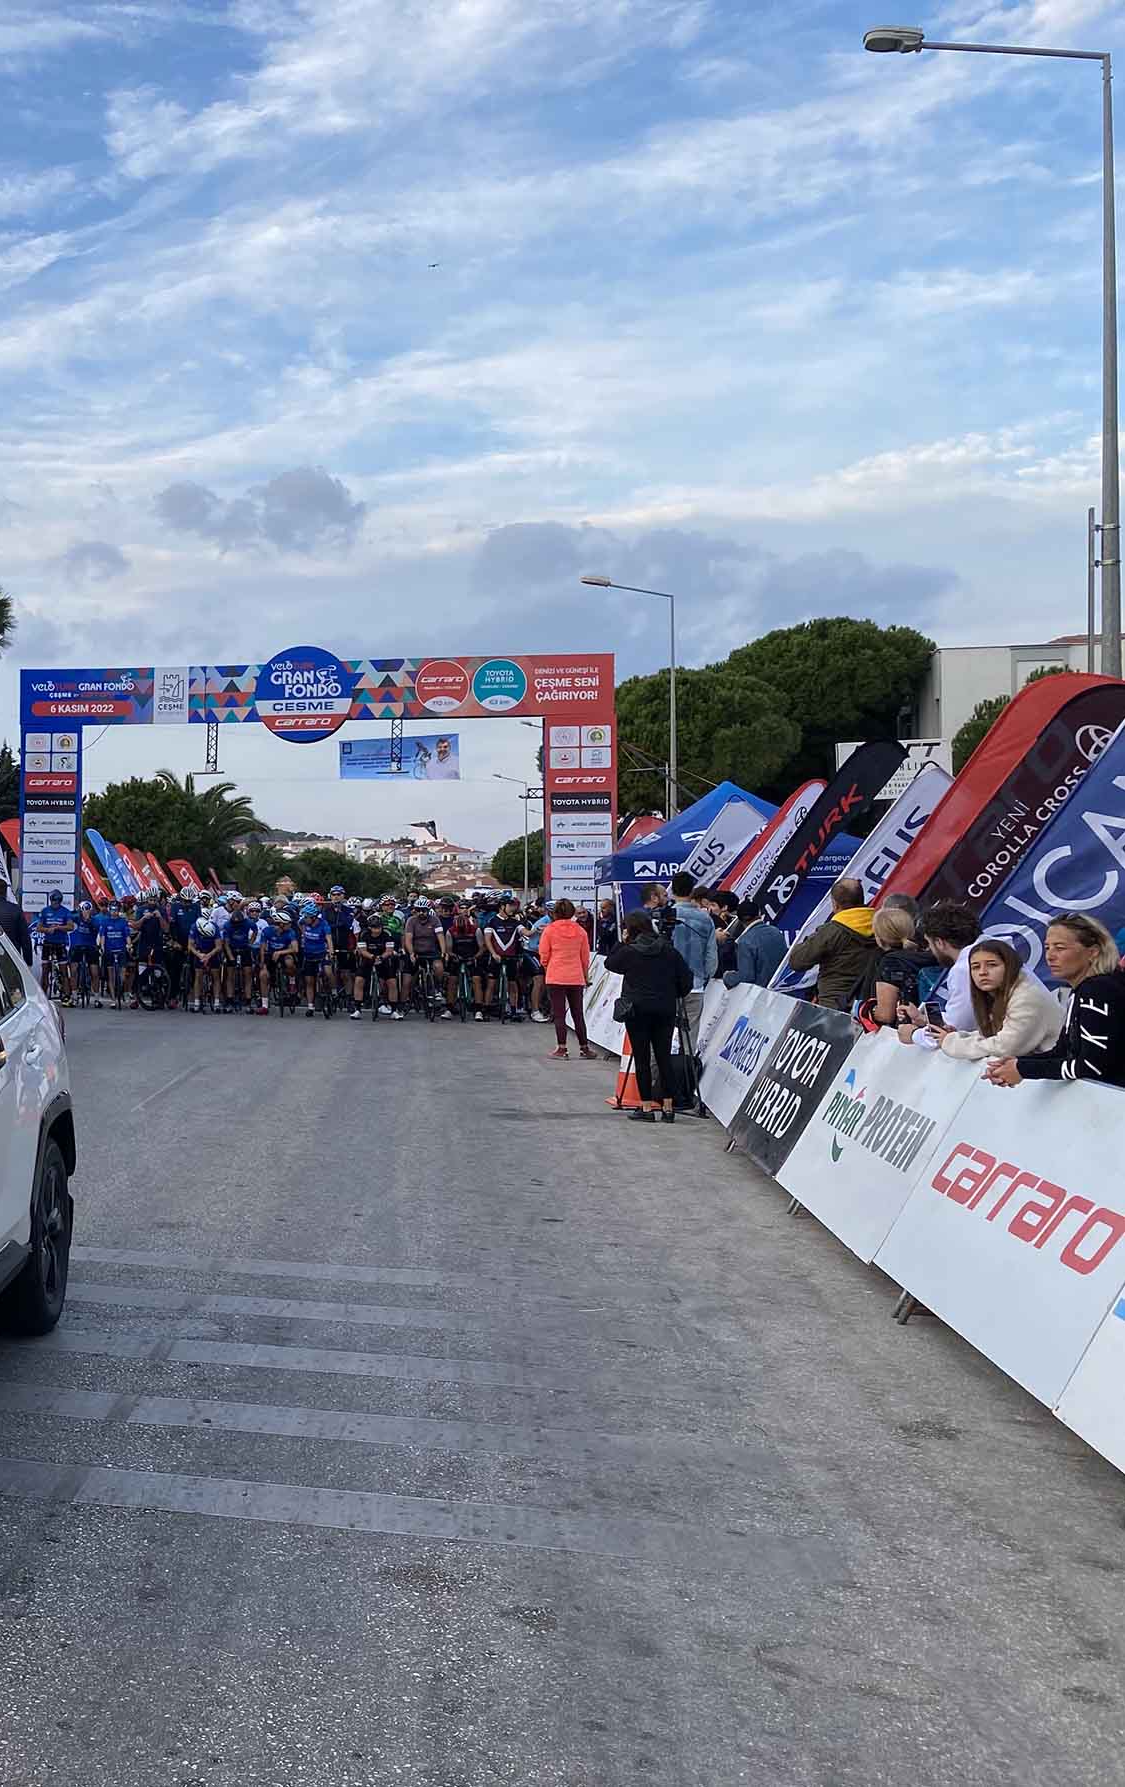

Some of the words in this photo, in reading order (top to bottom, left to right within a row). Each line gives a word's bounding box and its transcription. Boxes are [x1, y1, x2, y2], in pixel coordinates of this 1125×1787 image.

[78, 682, 102, 691] GRAN
[103, 682, 135, 691] FONDO
[270, 671, 314, 684] GRAN
[284, 683, 342, 697] FONDO
[535, 678, 572, 689] ÇEŞME
[574, 675, 599, 687] SENİ
[50, 704, 57, 713] 6
[58, 704, 89, 713] KASIM
[90, 704, 114, 713] 2022
[535, 689, 598, 703] ÇAĞIRIYOR!
[275, 718, 331, 726] carraro
[1036, 766, 1087, 822] CROSS
[990, 799, 1031, 841] YENİ
[968, 823, 1039, 898] COROLLA
[771, 1028, 831, 1088] TOYOTA
[746, 1076, 802, 1139] HYBRID
[854, 1095, 936, 1173] PROTEIN
[931, 1142, 1125, 1275] carraro
